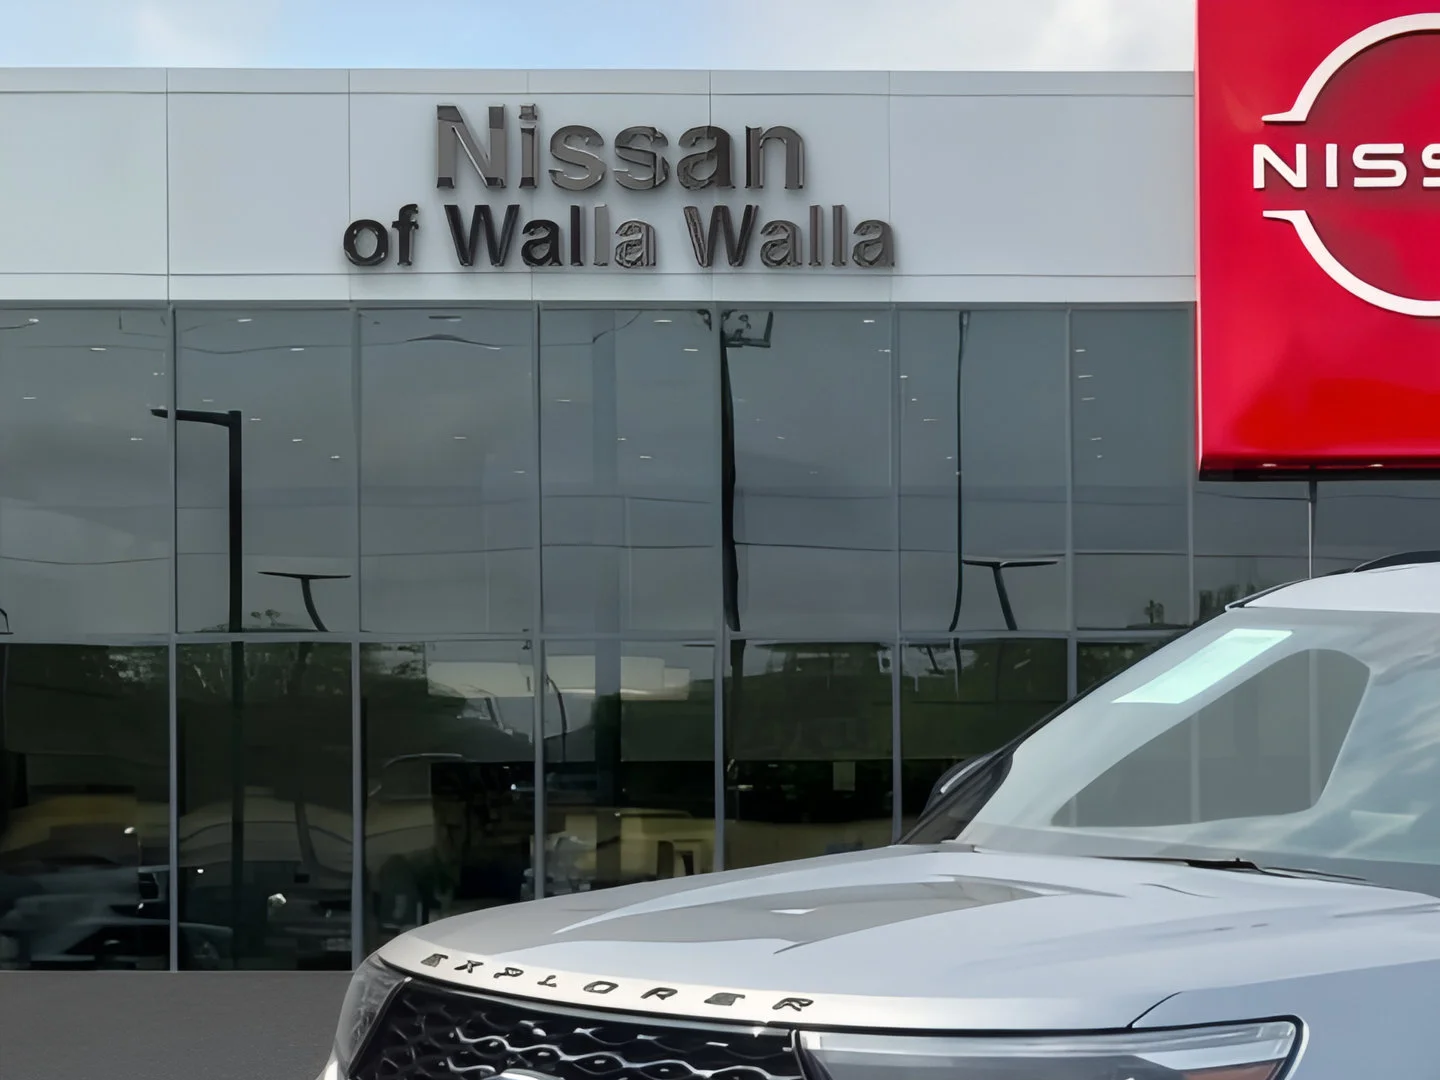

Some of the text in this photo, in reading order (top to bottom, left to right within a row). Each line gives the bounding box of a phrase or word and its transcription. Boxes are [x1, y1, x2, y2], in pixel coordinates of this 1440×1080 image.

[436, 103, 805, 190] Nissan
[343, 203, 896, 268] of Walla Walla
[420, 953, 814, 1011] EXPLORER
